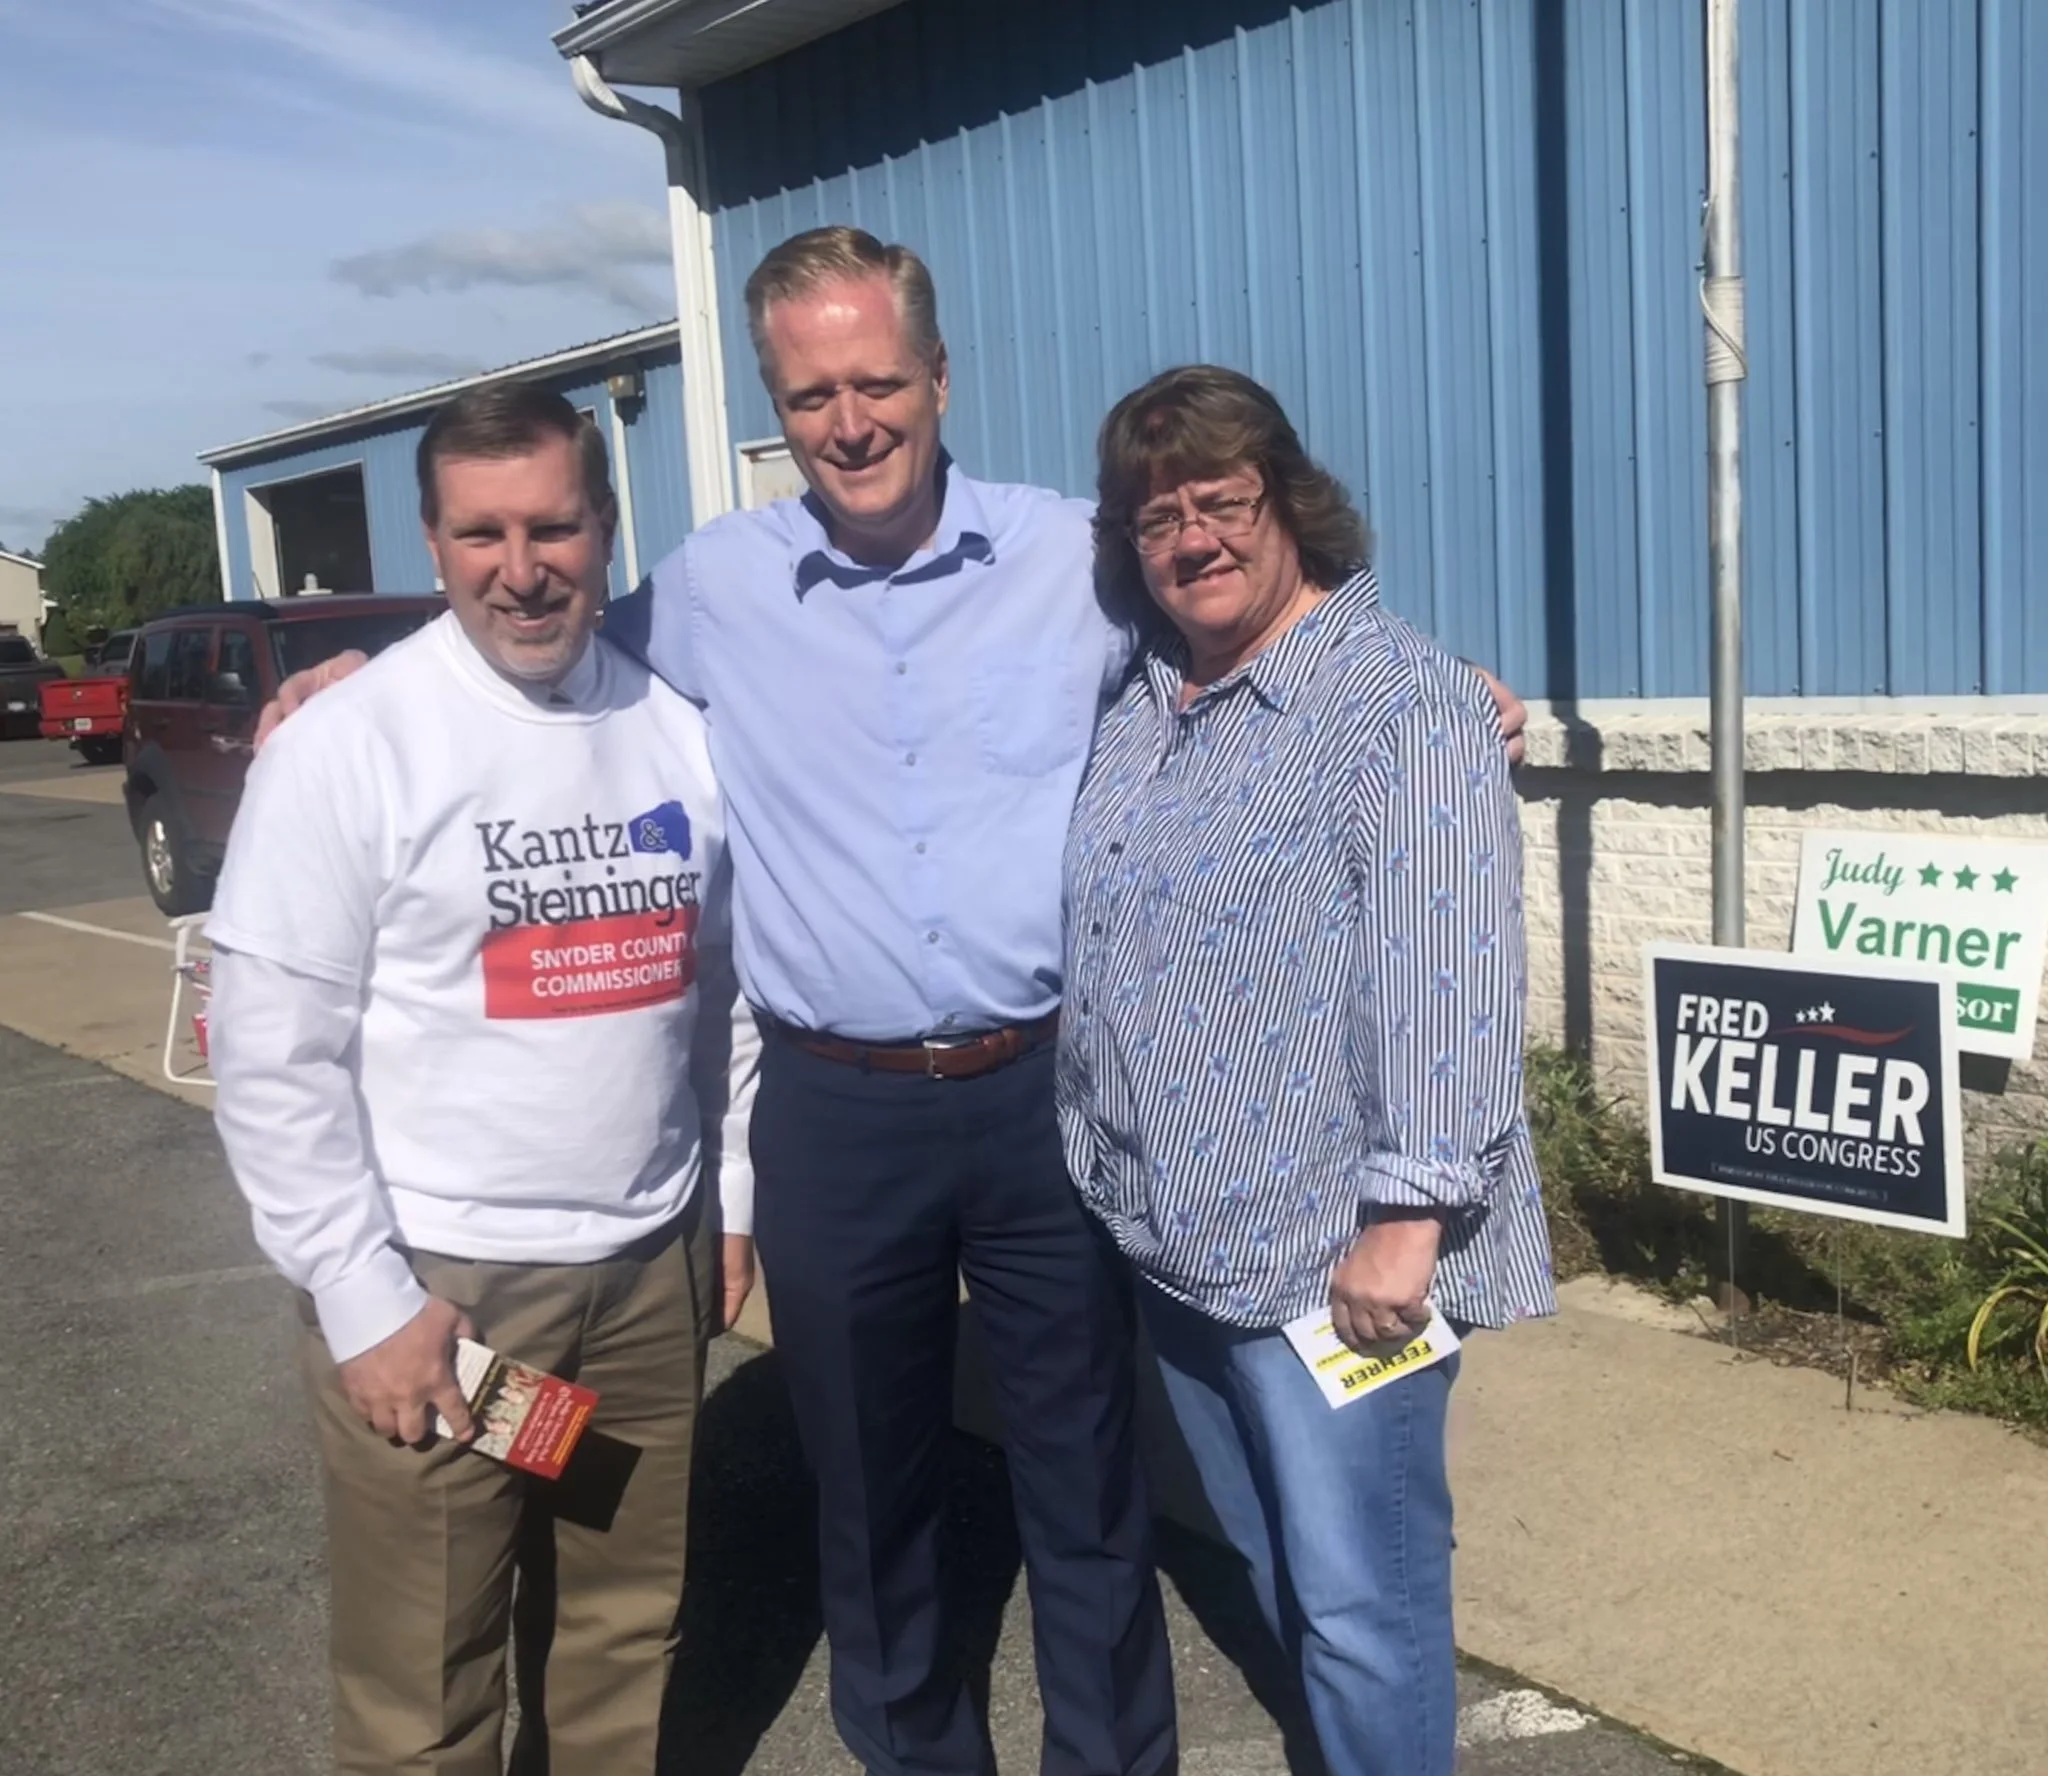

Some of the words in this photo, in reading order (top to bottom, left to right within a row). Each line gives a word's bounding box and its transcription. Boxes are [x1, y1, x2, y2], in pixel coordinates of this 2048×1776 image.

[475, 813, 630, 872] Kantz
[640, 818, 667, 850] &
[486, 865, 701, 930] Steininger
[1820, 848, 1905, 896] Judy
[531, 943, 616, 971] SNYDER
[1818, 899, 2022, 970] Varner
[1676, 994, 1769, 1039] FRED
[1671, 1033, 1930, 1146] KELLER
[1745, 1126, 1776, 1155] US
[1782, 1131, 1920, 1178] CONGRESS
